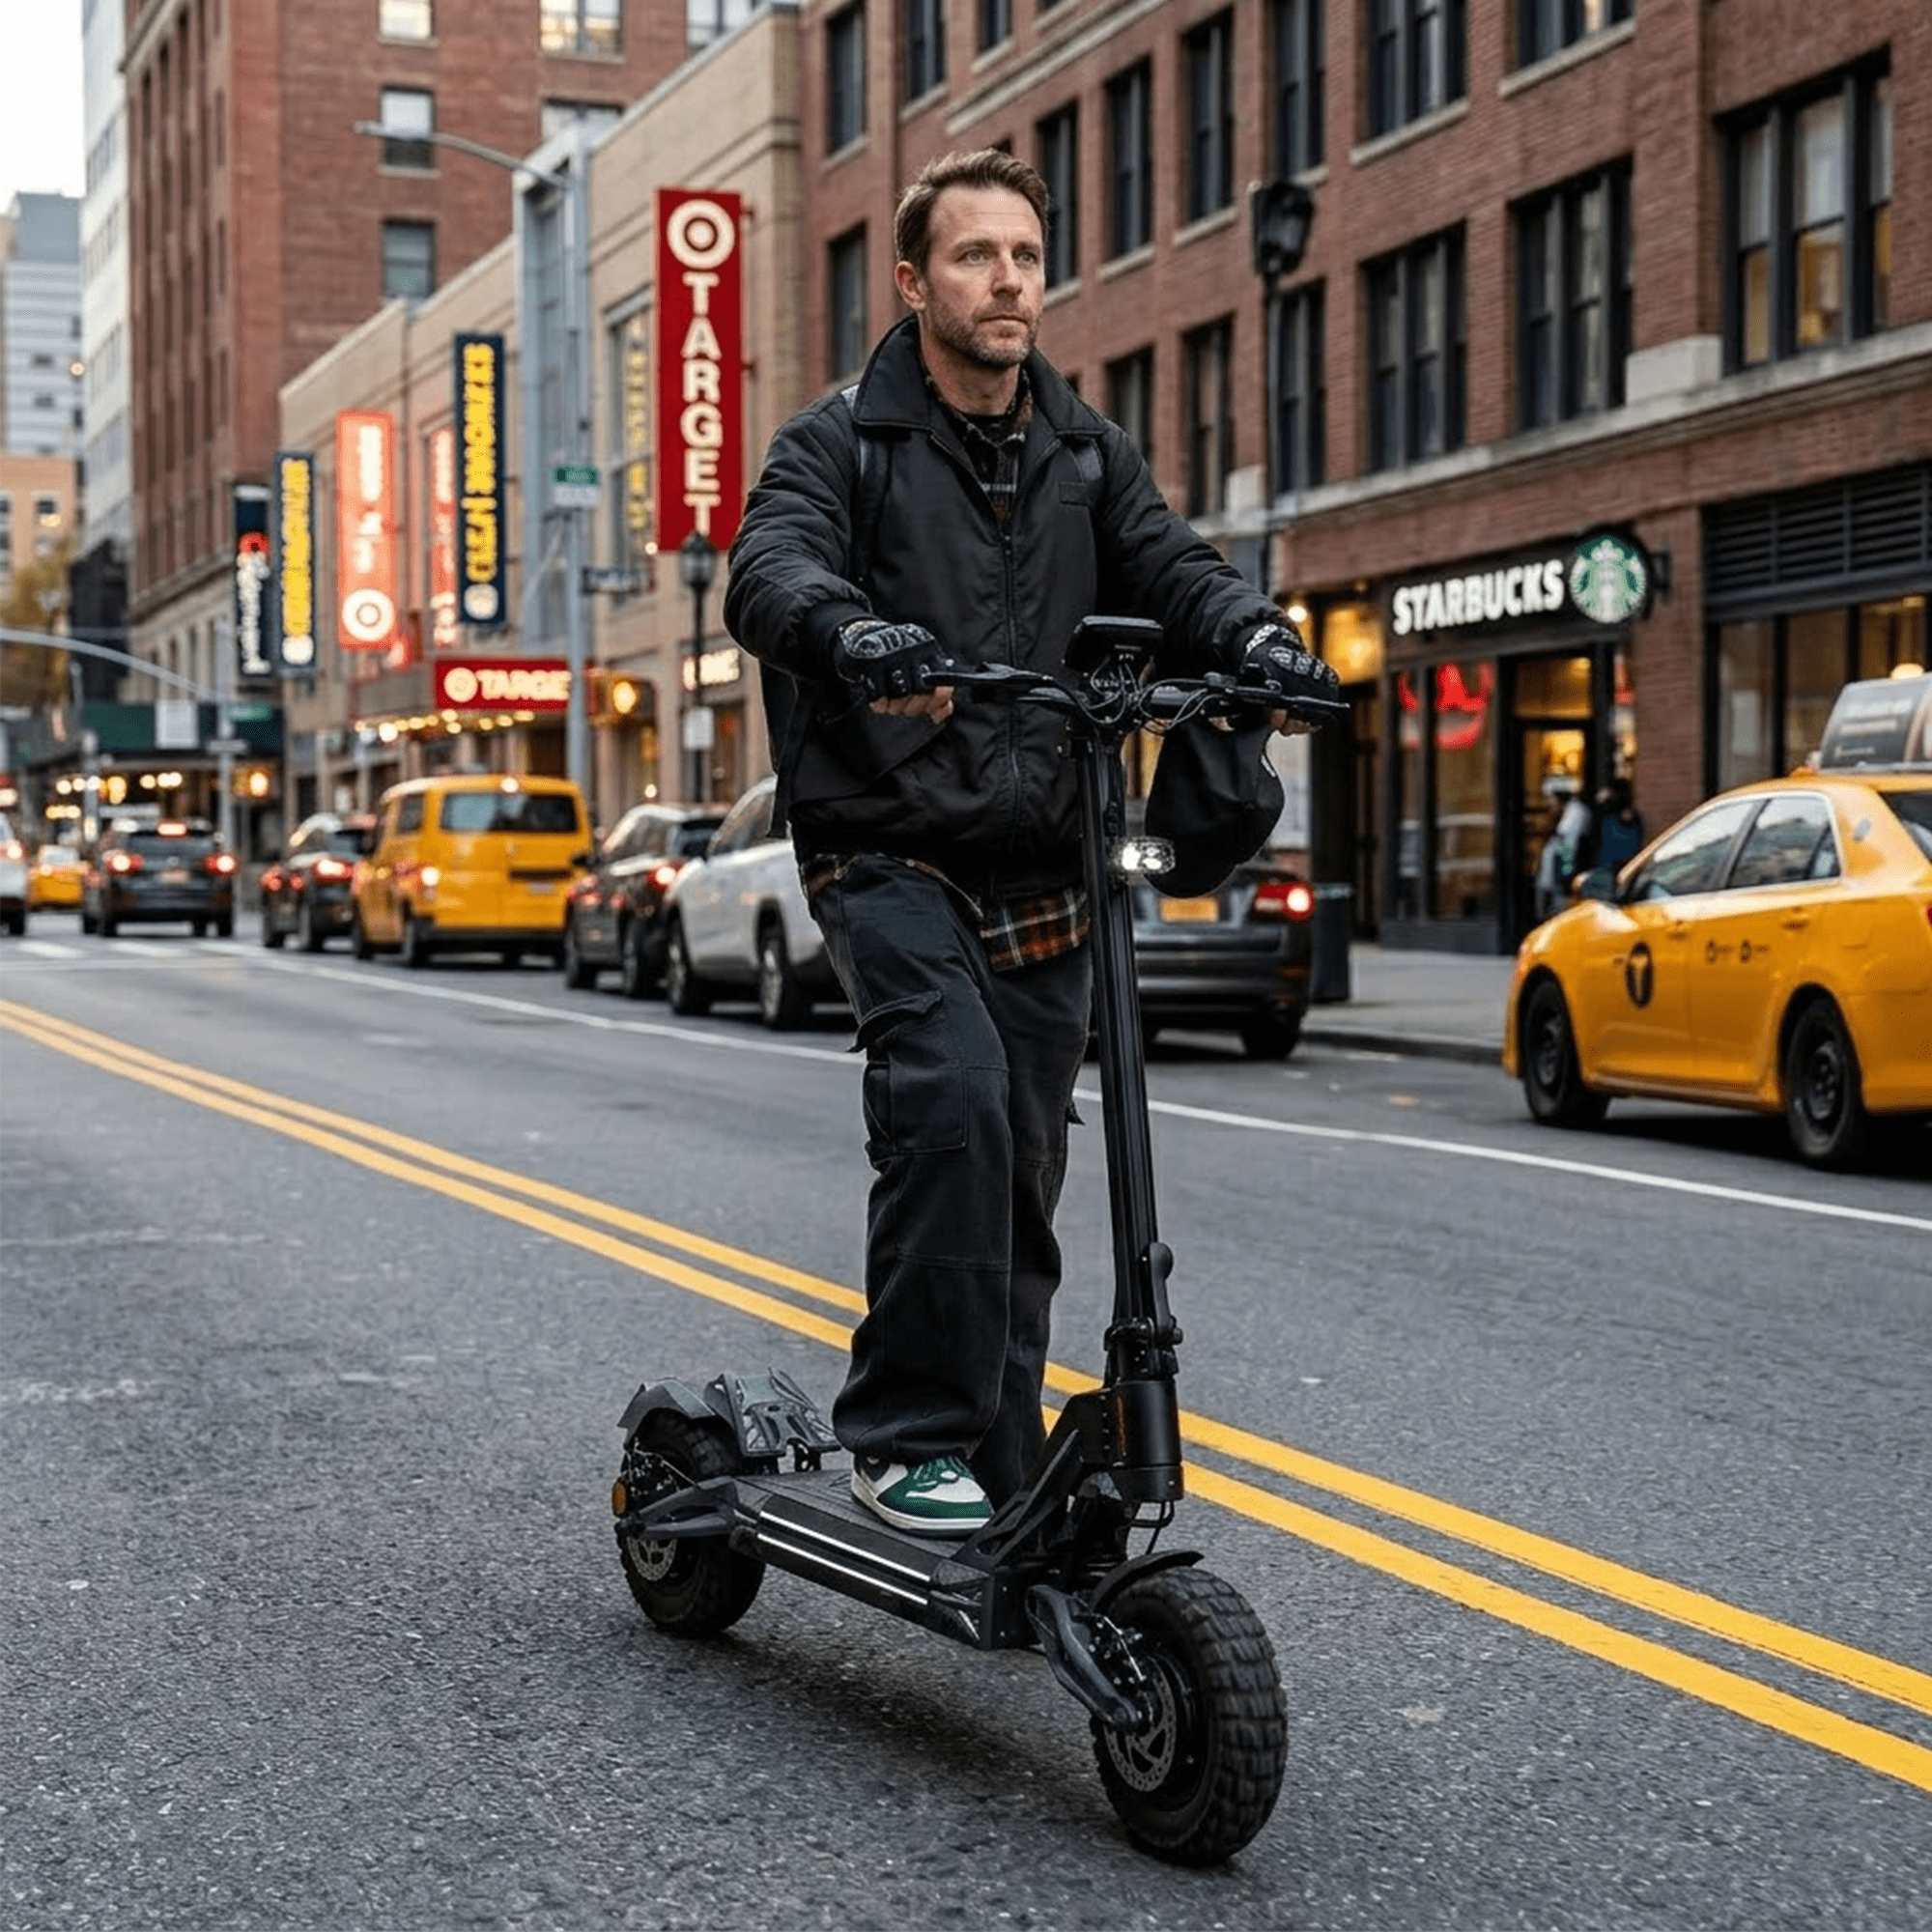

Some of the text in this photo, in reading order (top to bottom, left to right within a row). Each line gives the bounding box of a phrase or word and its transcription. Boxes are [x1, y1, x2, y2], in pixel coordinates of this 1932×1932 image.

[680, 271, 724, 536] TARGET
[1392, 558, 1565, 636] STARBUCKS
[474, 668, 572, 701] TARGE
